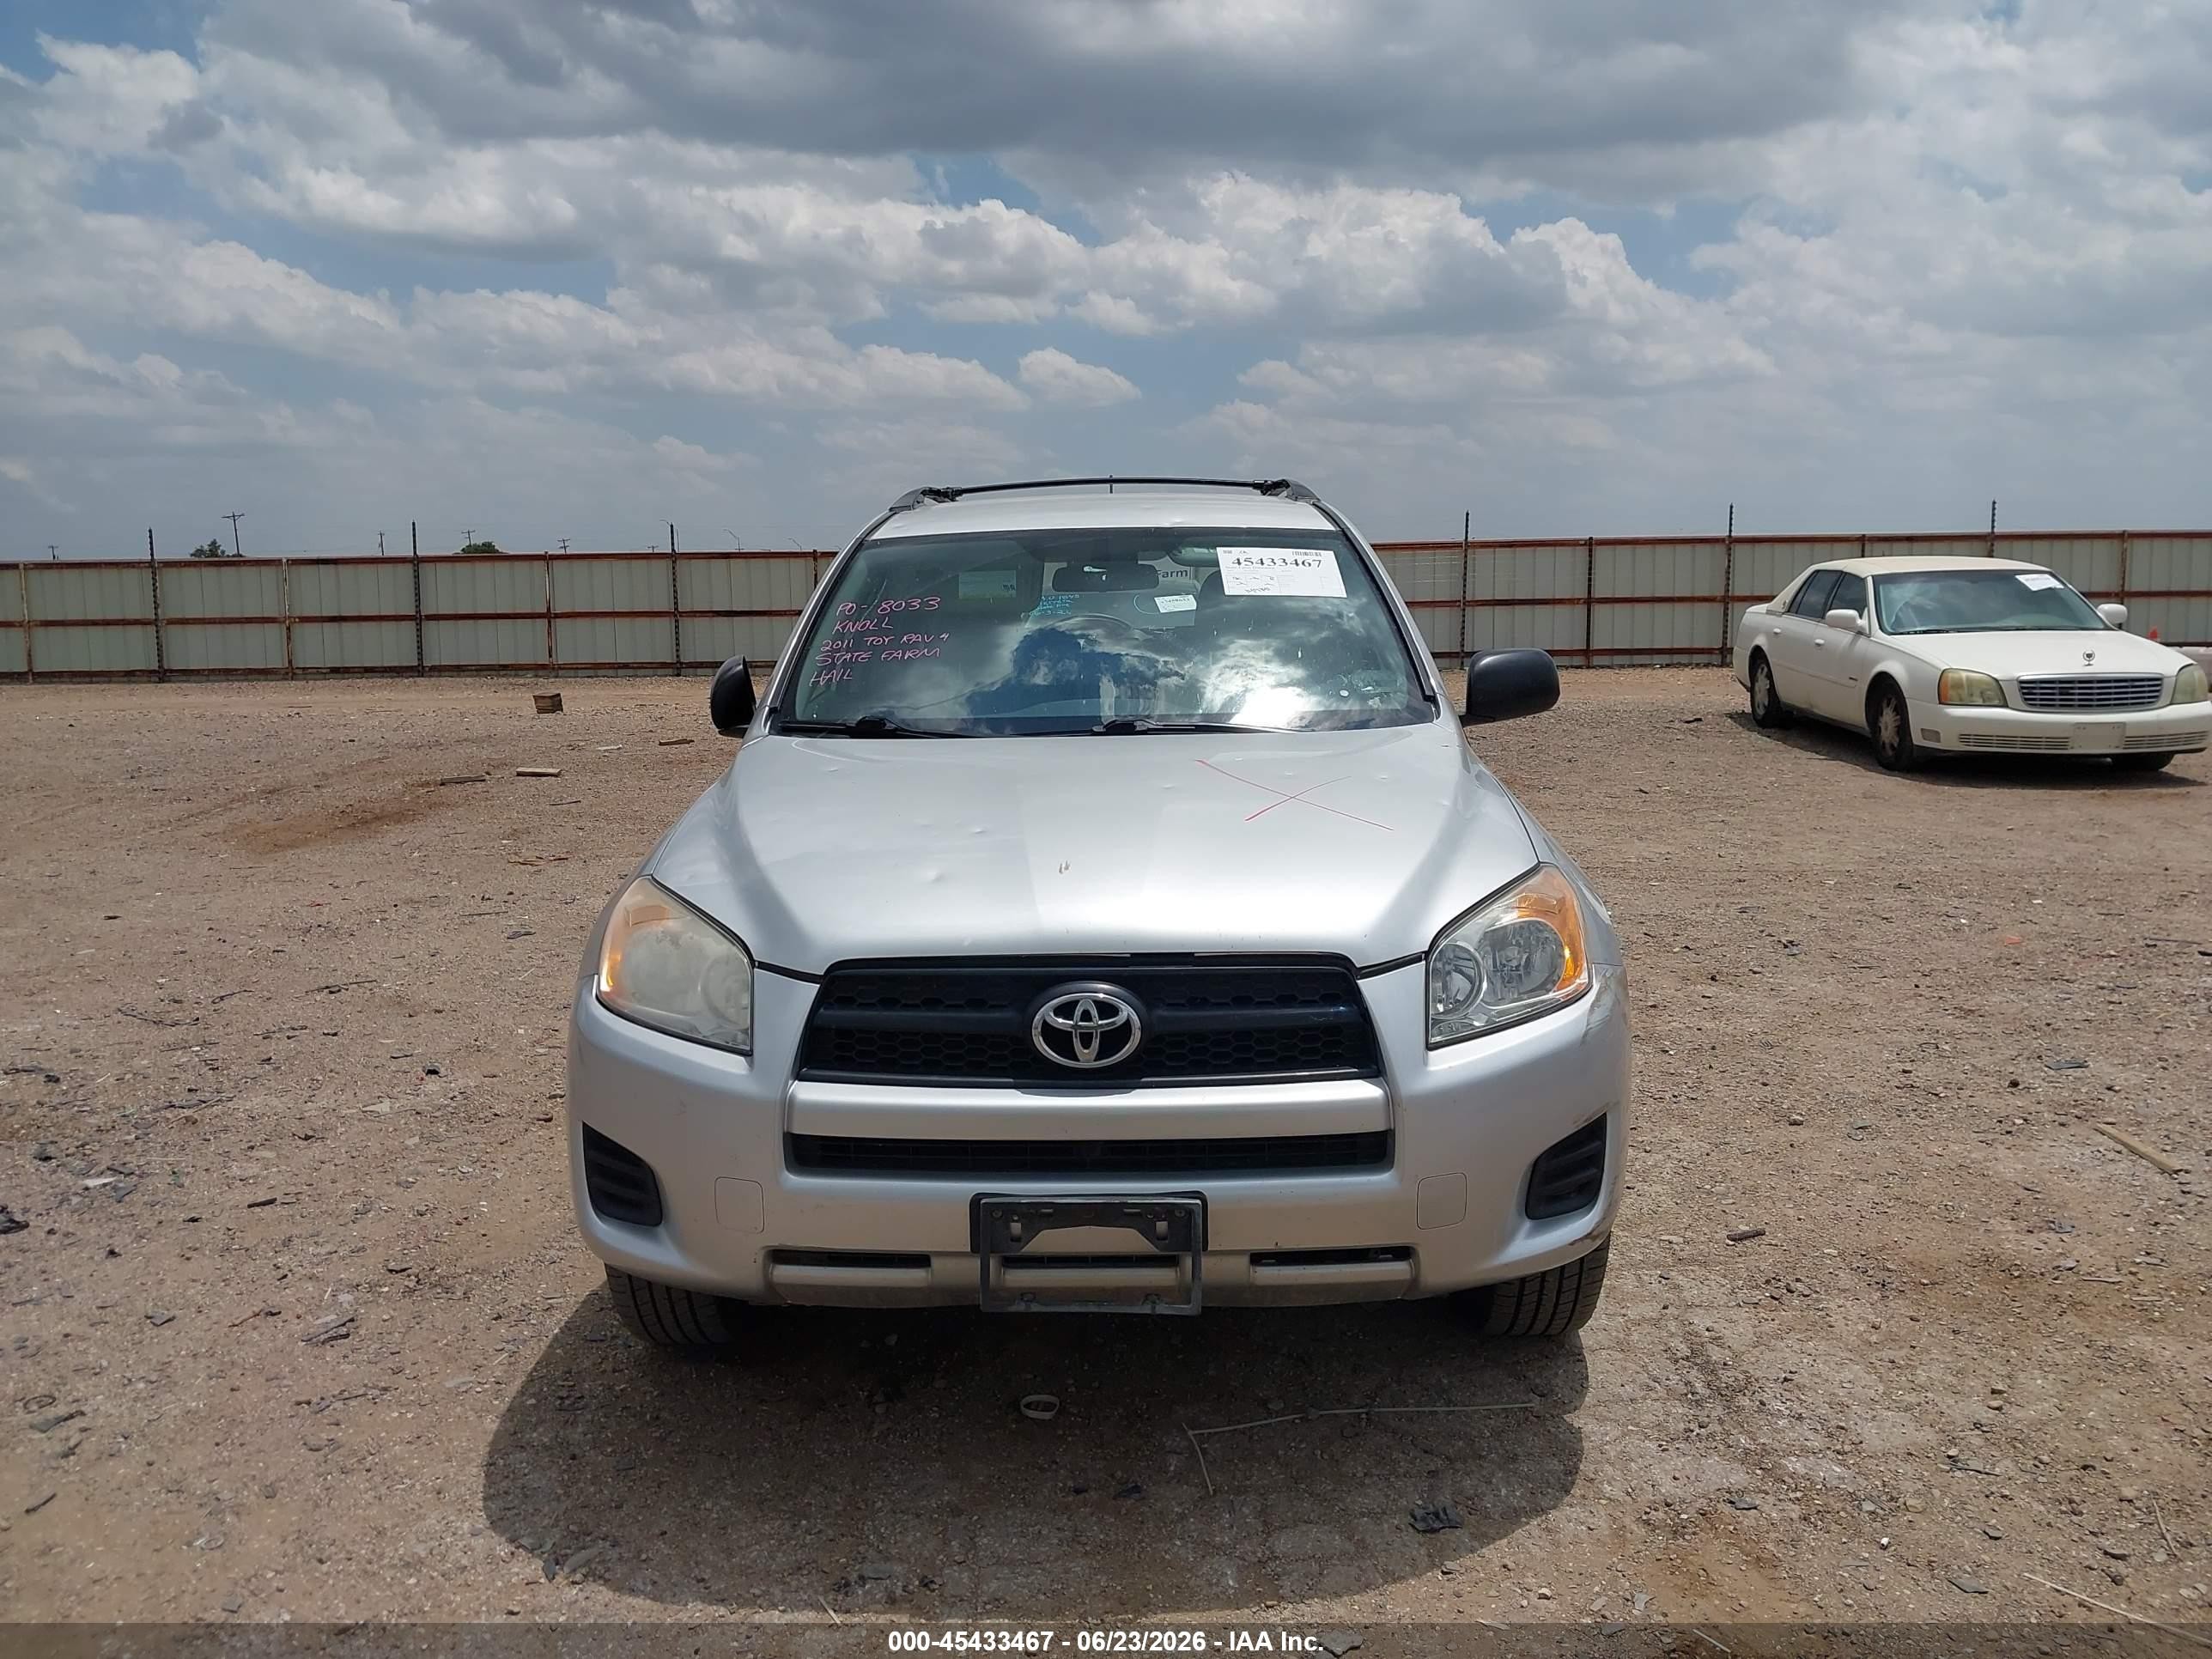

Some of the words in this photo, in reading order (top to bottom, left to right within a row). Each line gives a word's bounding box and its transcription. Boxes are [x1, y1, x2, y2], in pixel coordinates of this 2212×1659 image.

[1231, 557, 1322, 568] 45433467
[877, 597, 941, 615] 8033
[832, 617, 894, 635] KNOLL
[820, 639, 853, 652] 2011
[863, 635, 895, 646] TOY
[815, 651, 872, 666] STATE
[880, 647, 941, 661] FARM
[809, 668, 853, 687] HAIL
